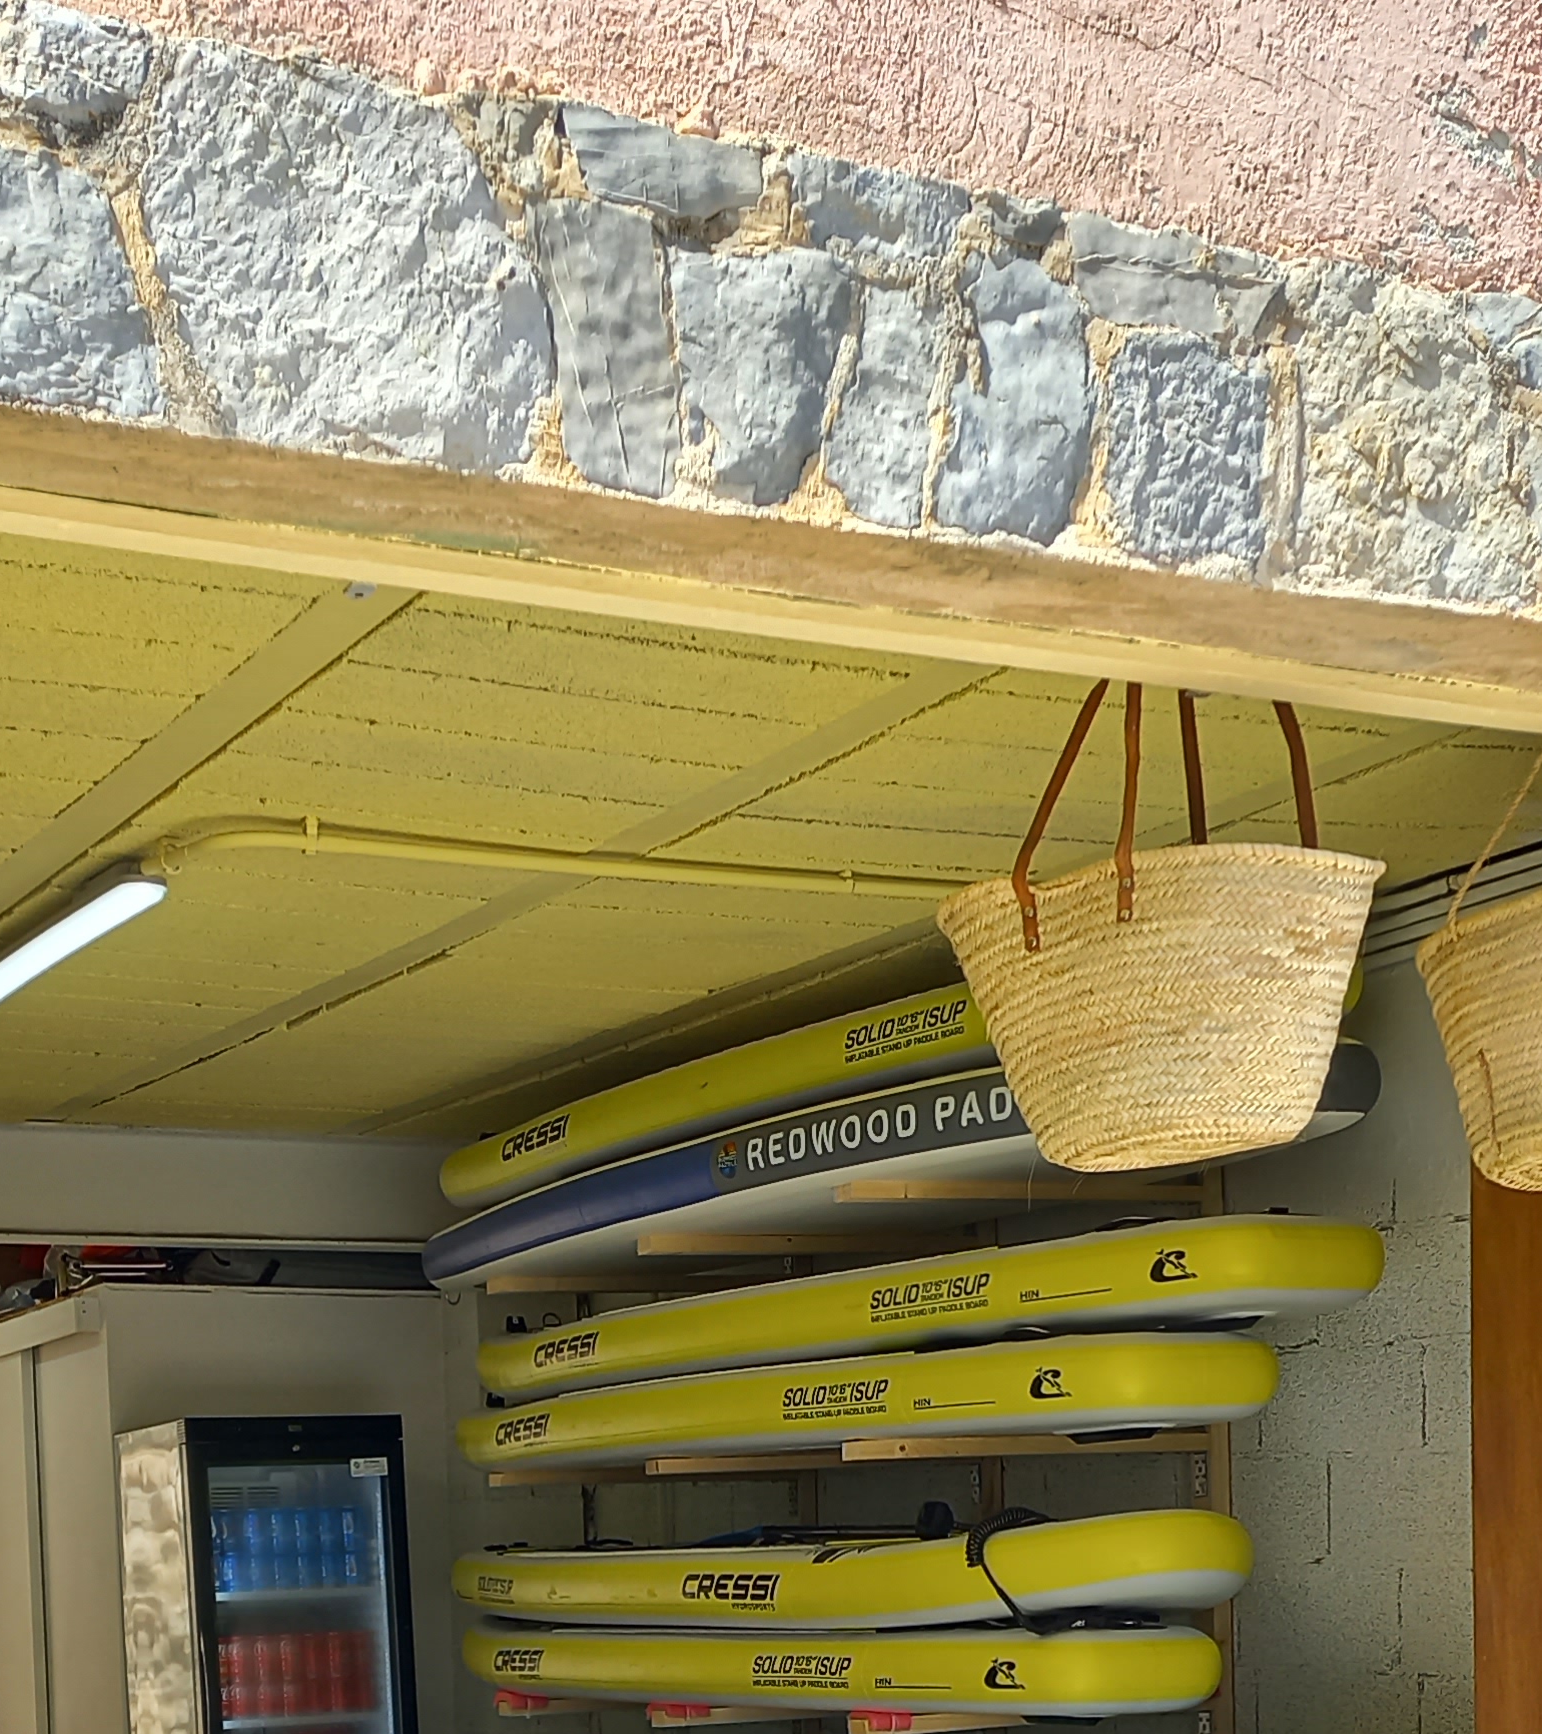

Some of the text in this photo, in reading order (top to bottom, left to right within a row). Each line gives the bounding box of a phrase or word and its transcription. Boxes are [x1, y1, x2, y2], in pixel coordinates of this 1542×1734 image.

[844, 1018, 896, 1050] SOLID
[921, 1000, 967, 1029] ISUP
[501, 1112, 571, 1162] CRESSI
[746, 1085, 1012, 1171] REDWOOD PAD
[870, 1283, 920, 1310] SOLID
[946, 1273, 990, 1298] ISUP
[1020, 1289, 1040, 1300] HIN
[533, 1331, 600, 1368] CRESSI
[782, 1385, 827, 1407] SOLID
[849, 1379, 889, 1402] ISUP
[495, 1412, 551, 1447] CRESSI
[681, 1573, 780, 1601] CRESSI
[493, 1649, 545, 1672] CRESSI
[752, 1655, 795, 1675] SOLID
[814, 1656, 852, 1677] ISUP
